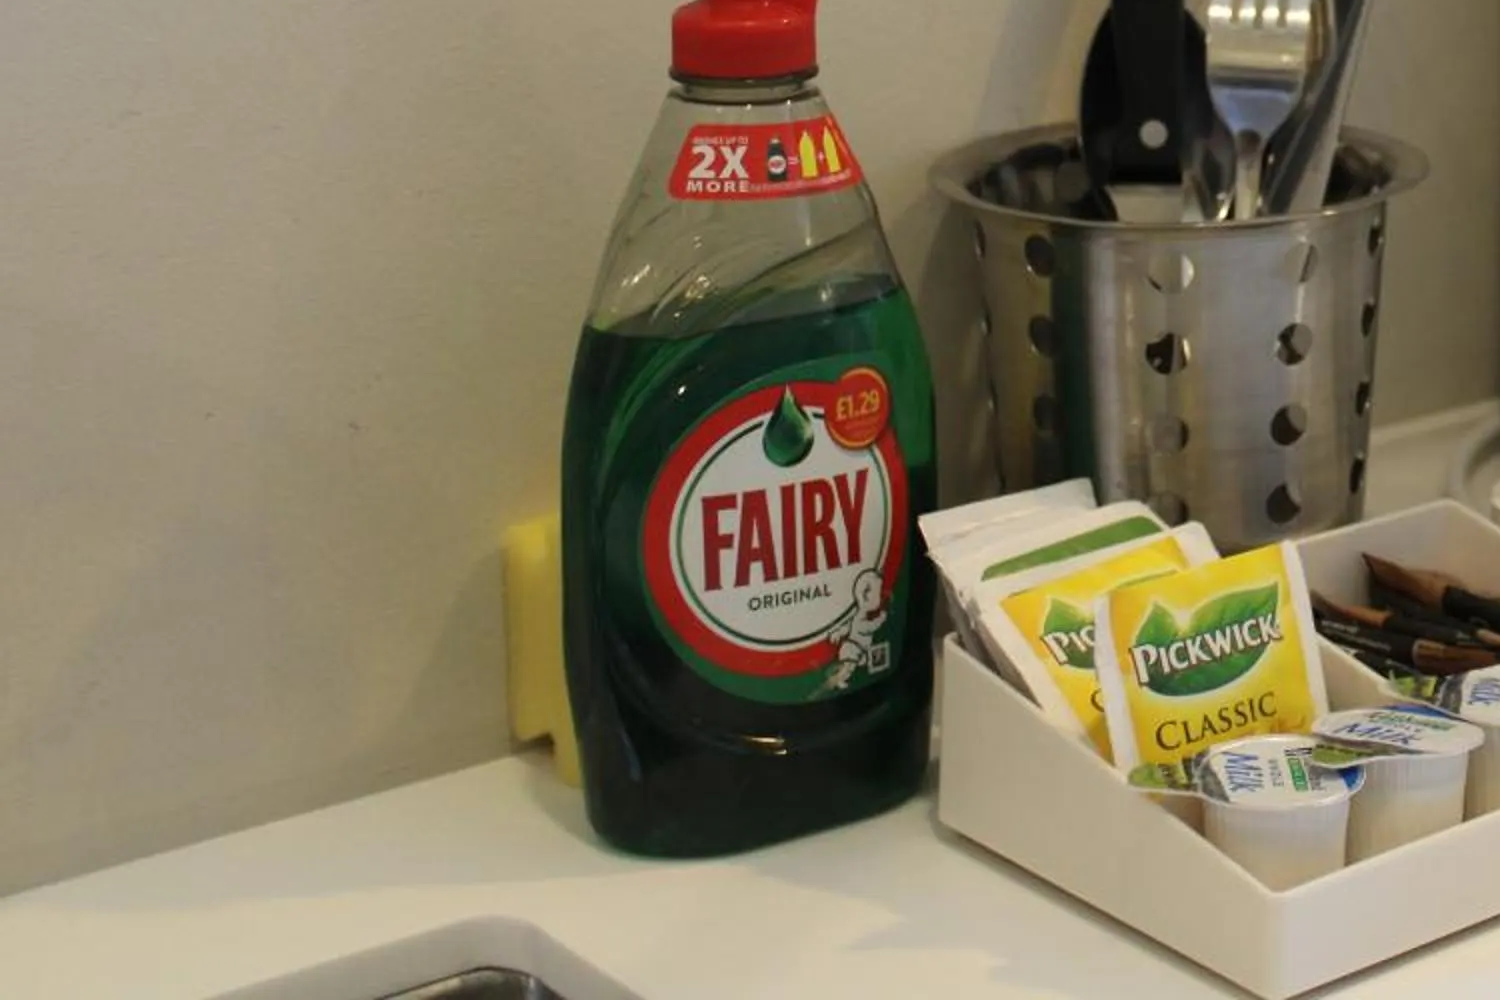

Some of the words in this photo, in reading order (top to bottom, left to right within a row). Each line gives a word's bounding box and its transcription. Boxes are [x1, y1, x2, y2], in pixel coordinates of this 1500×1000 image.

[688, 146, 749, 178] 2X
[686, 180, 749, 193] MORE
[836, 390, 880, 421] £1.29
[701, 468, 869, 592] FAIRY
[747, 583, 832, 612] ORIGINAL
[1129, 612, 1282, 687] PICKWICK
[1155, 691, 1277, 752] CLASSIC
